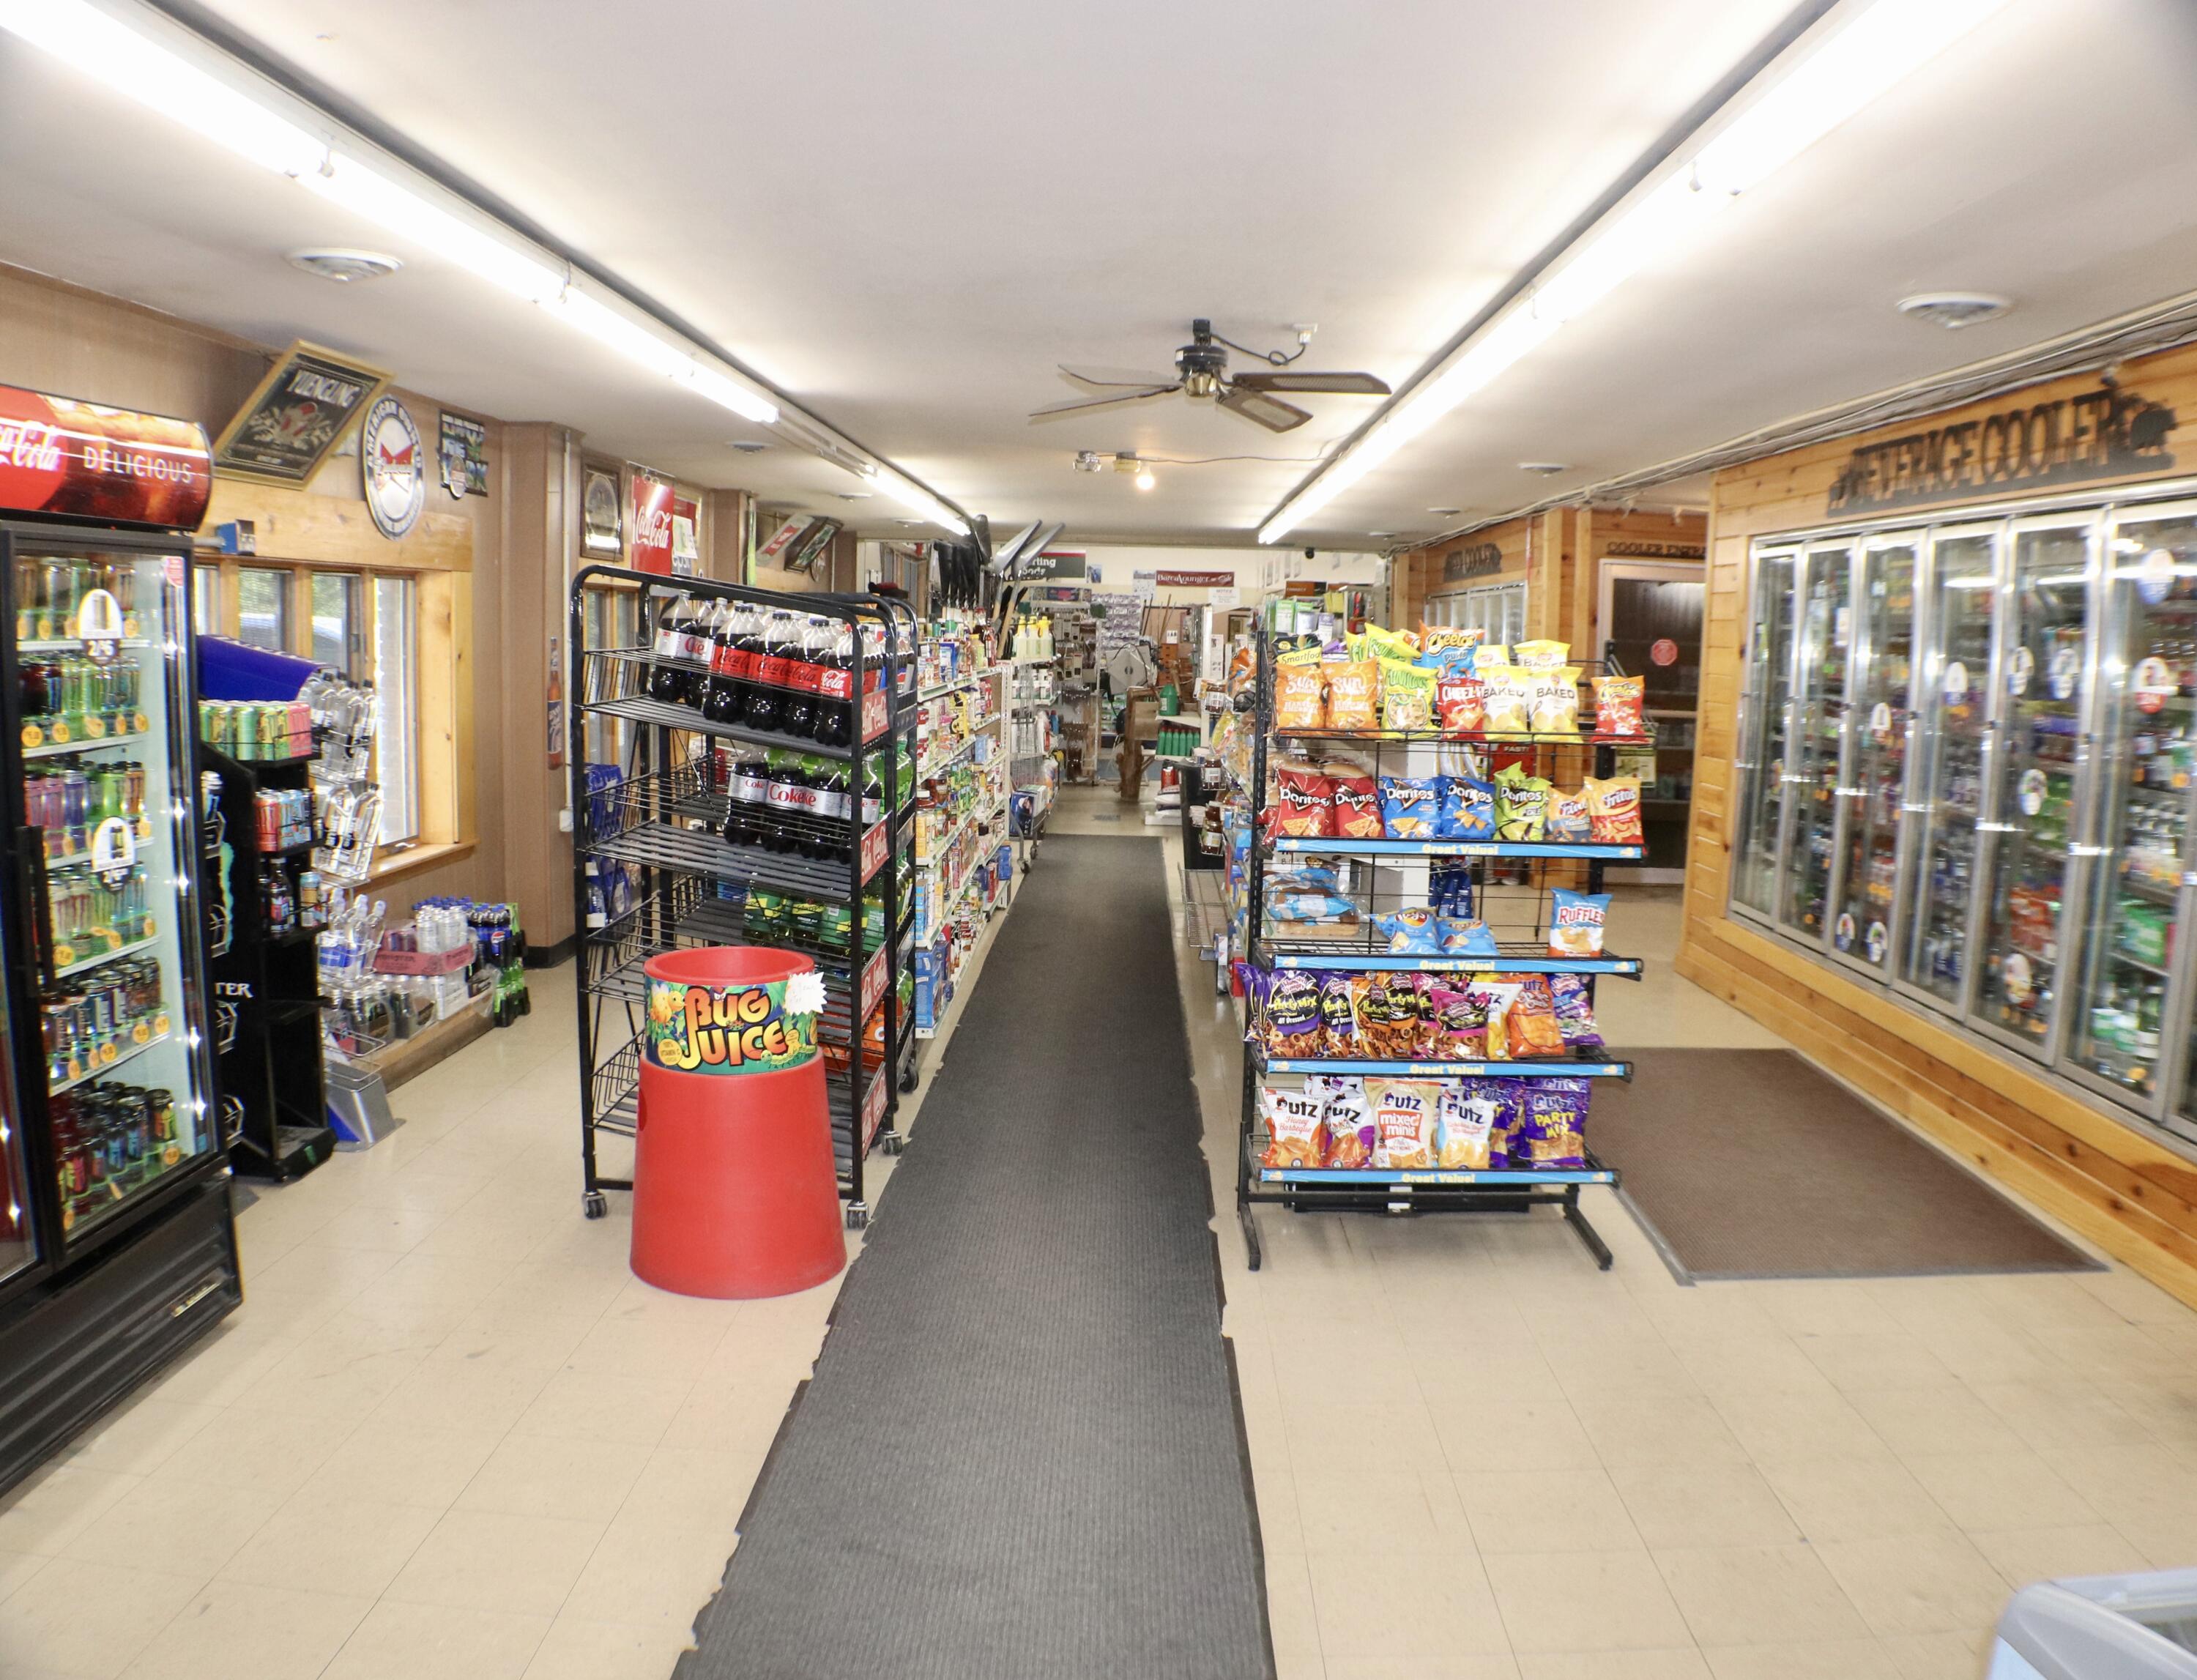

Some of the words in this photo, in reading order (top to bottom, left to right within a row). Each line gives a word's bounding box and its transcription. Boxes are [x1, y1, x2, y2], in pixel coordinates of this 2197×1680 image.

[289, 369, 362, 408] YUENGLING
[1981, 390, 2115, 485] COOLER
[83, 445, 193, 484] DELICIOUS
[636, 505, 669, 549] Coca-Cola
[1032, 555, 1056, 568] rting
[1022, 565, 1046, 576] oods
[1427, 632, 1475, 655] Cheetos
[1282, 649, 1320, 664] Smartfoo
[1483, 687, 1525, 699] BAKED
[1537, 687, 1575, 699] BAKED
[744, 778, 765, 790] Coke
[1280, 787, 1330, 807] Doritos
[1386, 787, 1435, 800] Doritos
[1447, 784, 1493, 803] Doritos
[1500, 786, 1542, 803] Doritos
[1601, 789, 1637, 809] Fritos
[1422, 844, 1457, 855] Great
[1459, 844, 1499, 855] Value!
[1558, 908, 1605, 926] RUFFLES
[1420, 960, 1454, 970] Great
[1457, 960, 1495, 971] Value!
[1274, 997, 1298, 1011] Party
[1297, 995, 1317, 1008] Mix
[1323, 998, 1347, 1014] Party
[1406, 995, 1416, 1003] M
[684, 986, 771, 1029] BUG
[677, 1020, 788, 1070] JUICE
[1410, 1065, 1443, 1075] Great
[1447, 1065, 1485, 1075] Value!
[1289, 1101, 1318, 1118] utz
[1394, 1096, 1421, 1110] utz
[1285, 1115, 1309, 1126] Honey
[1380, 1112, 1420, 1126] mixed
[1459, 1106, 1484, 1124] utz
[1534, 1111, 1576, 1127] PARTY
[1386, 1123, 1416, 1137] minis
[1545, 1124, 1570, 1139] MIX
[1402, 1172, 1435, 1183] Great
[1439, 1173, 1476, 1183] Value!
